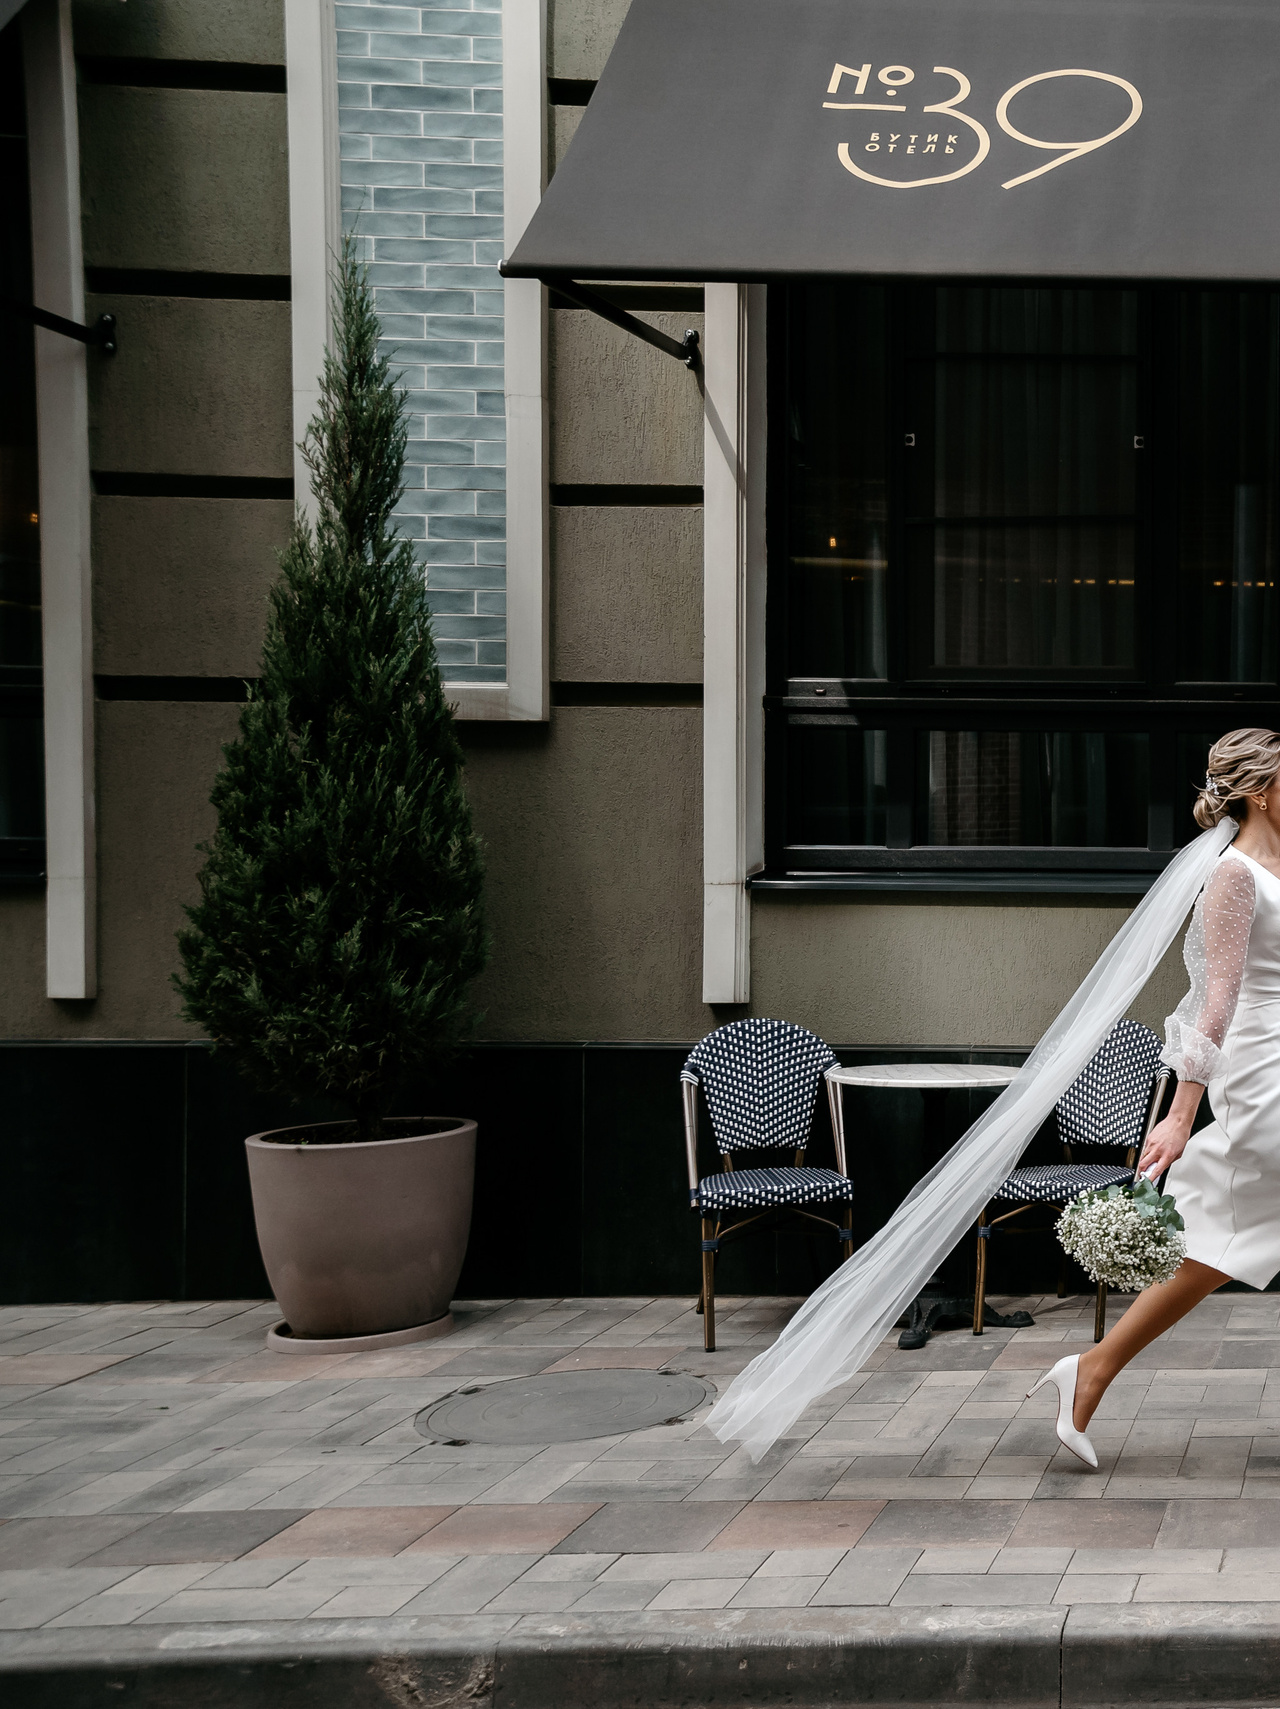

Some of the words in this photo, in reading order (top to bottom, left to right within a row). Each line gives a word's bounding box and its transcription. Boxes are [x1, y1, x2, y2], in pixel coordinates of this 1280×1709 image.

[837, 66, 1144, 190] 39
[869, 132, 959, 145] БУТИК
[864, 142, 955, 155] ОТЕЛЬ
